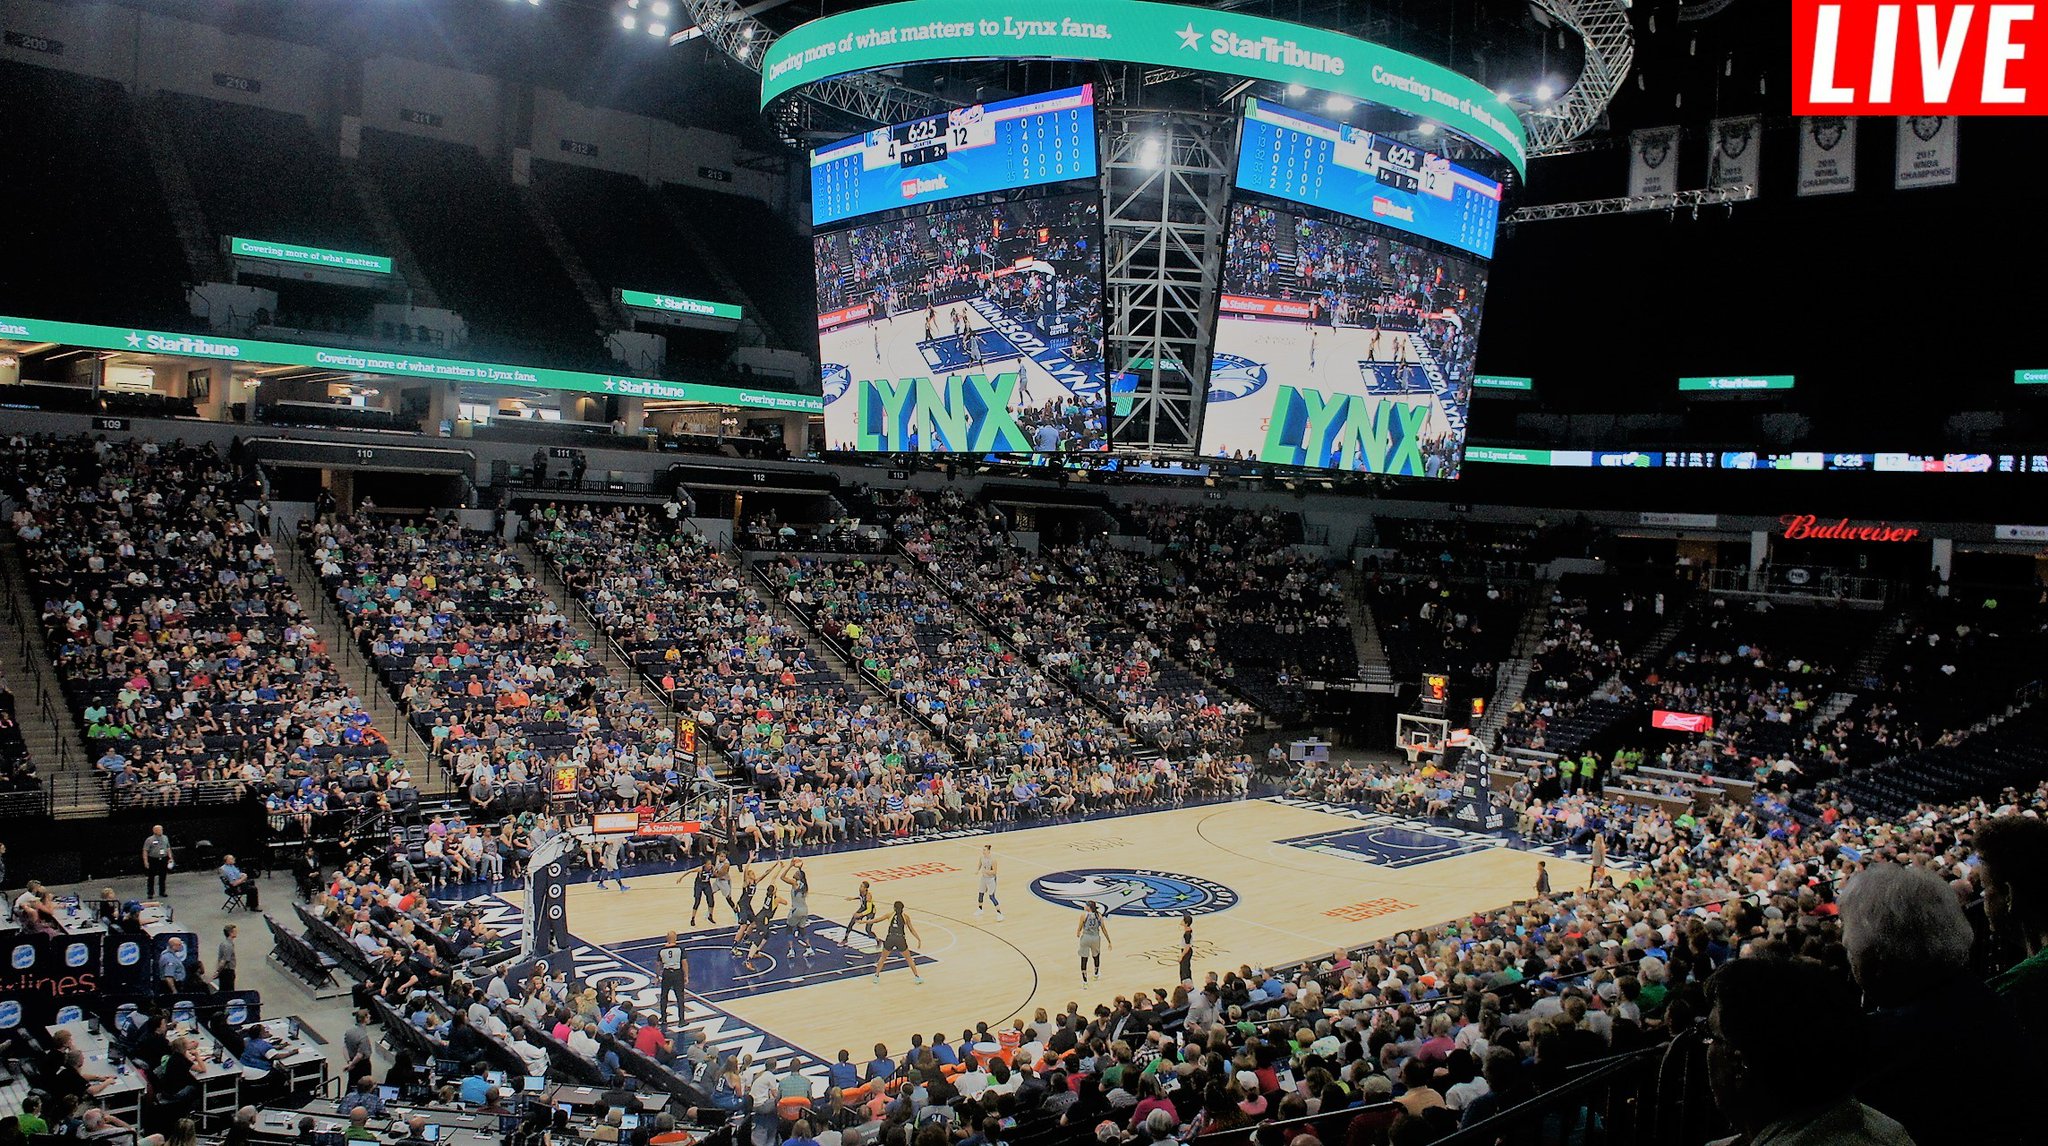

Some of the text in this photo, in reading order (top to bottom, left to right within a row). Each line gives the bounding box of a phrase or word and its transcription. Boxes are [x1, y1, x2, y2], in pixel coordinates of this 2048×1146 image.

[769, 16, 1112, 81] Covering more of what matters to Lynx fans.
[1210, 29, 1345, 76] StarTribune
[1371, 65, 1430, 102] Covering
[1021, 118, 1027, 129] 0
[1037, 115, 1043, 126] 0
[1054, 112, 1058, 123] 1
[1071, 109, 1078, 120] 0
[908, 119, 937, 143] 6:25
[953, 127, 968, 146] 12
[1022, 131, 1028, 141] 4
[1038, 128, 1044, 139] 0
[1055, 125, 1059, 136] 1
[1071, 122, 1078, 133] 0
[1276, 128, 1282, 139] 0
[1291, 132, 1297, 143] 0
[1306, 136, 1312, 147] 0
[1320, 141, 1326, 151] 0
[888, 144, 895, 159] 4
[913, 140, 932, 148] QUARTER
[1022, 143, 1029, 154] 0
[1039, 141, 1043, 151] 1
[1055, 138, 1062, 149] 0
[1072, 135, 1079, 146] 0
[1274, 140, 1281, 151] 0
[1290, 144, 1294, 155] 1
[1304, 149, 1311, 159] 0
[921, 150, 925, 162] 1
[1023, 156, 1029, 167] 6
[1039, 153, 1045, 164] 0
[1055, 150, 1062, 161] 0
[1073, 148, 1079, 159] 0
[1365, 152, 1372, 169] 4
[1387, 144, 1415, 169] 6:25
[1915, 150, 1936, 160] 2017
[708, 169, 723, 180] 213
[1024, 168, 1030, 179] 2
[1040, 166, 1045, 177] 0
[1056, 163, 1063, 174] 0
[1073, 161, 1080, 172] 0
[1900, 167, 1951, 181] CHAMPIONS
[1269, 178, 1276, 189] 2
[1395, 175, 1400, 187] 1
[1425, 171, 1435, 190] 12
[1802, 176, 1850, 187] CHAMPIONS
[241, 243, 381, 268] Covering more of what matters.
[664, 298, 715, 314] StarTribune
[146, 335, 240, 357] StarTribune
[316, 351, 538, 383] Covering more of what matters to Lynx fans.
[618, 379, 685, 398] StarTribune
[740, 392, 775, 406] Covering
[777, 397, 796, 407] more
[798, 397, 805, 408] of
[858, 373, 1033, 452] LYNX
[102, 420, 121, 429] 109
[1261, 384, 1429, 477] LYNX
[357, 450, 373, 459] 110
[556, 449, 570, 457] 111
[1833, 454, 1863, 466] 6:25
[752, 473, 765, 482] 112
[893, 471, 904, 479] 113
[1778, 514, 1919, 542] Budweiser
[851, 862, 946, 878] CENTER
[867, 866, 963, 883] TARGET
[1135, 869, 1234, 907] MINNESOTA
[1144, 905, 1216, 918] LYNX
[1319, 897, 1398, 917] CENTER
[1342, 902, 1419, 922] TARGET
[667, 950, 673, 959] 9
